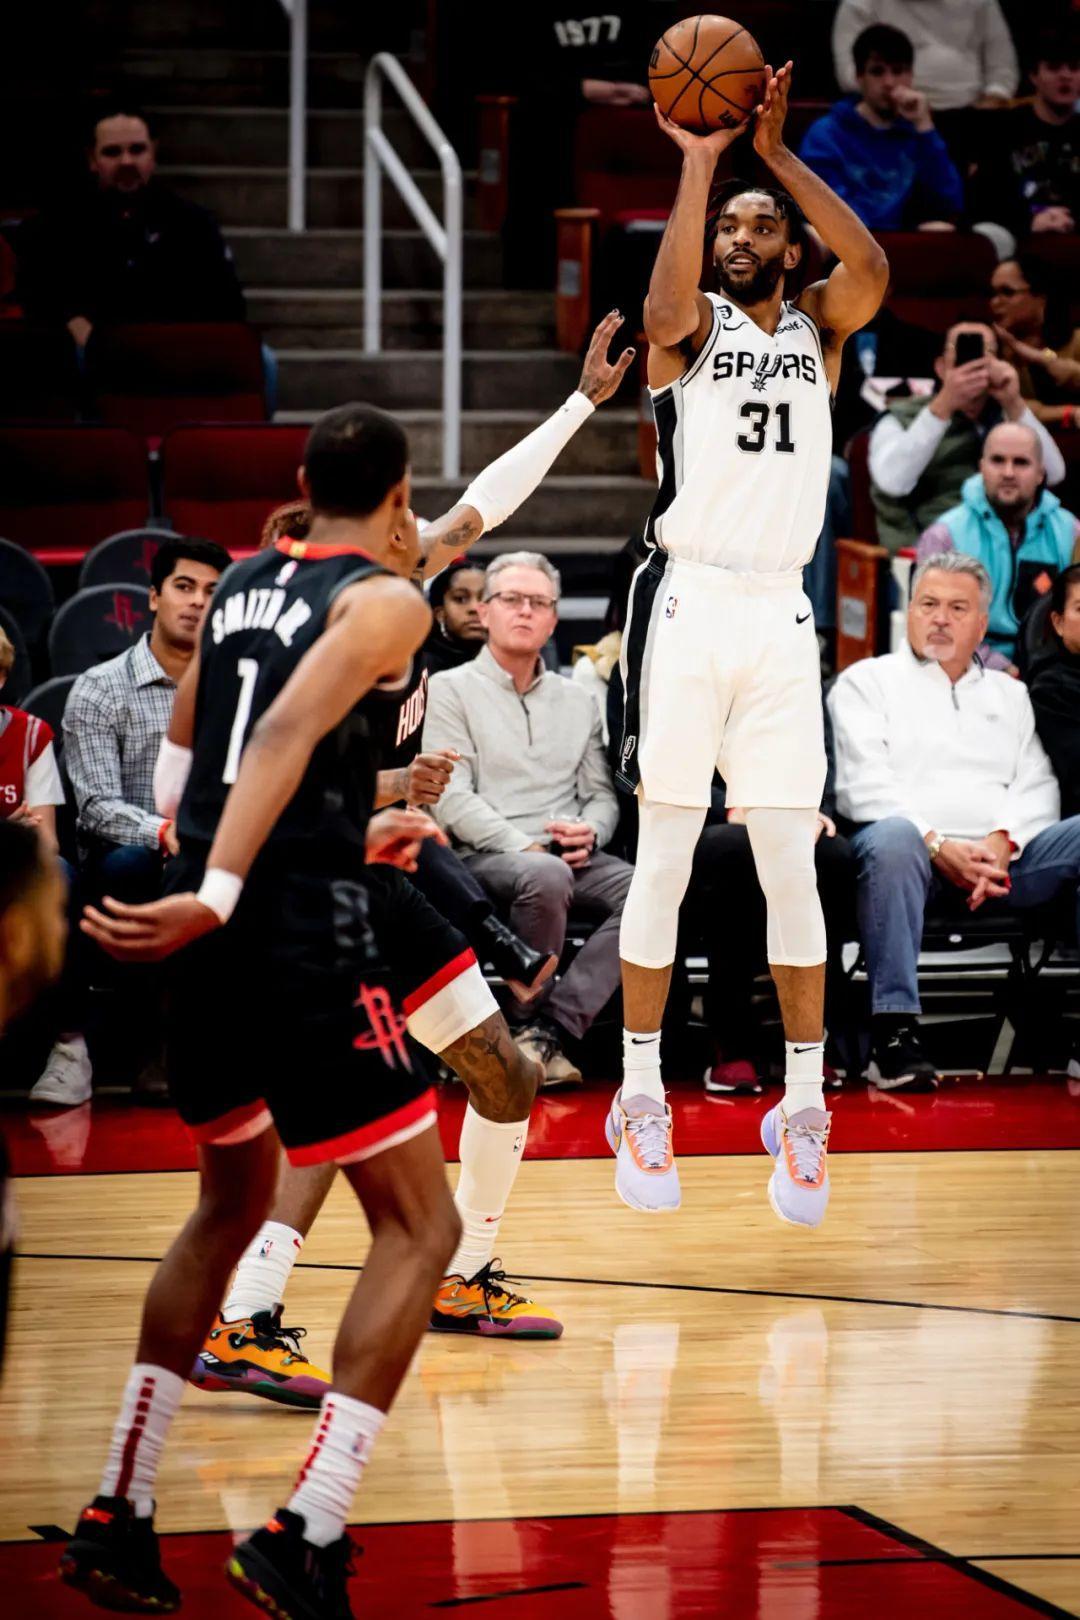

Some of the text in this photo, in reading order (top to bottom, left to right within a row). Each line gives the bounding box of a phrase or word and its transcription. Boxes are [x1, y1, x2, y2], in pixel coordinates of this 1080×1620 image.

[713, 351, 817, 392] SPURS
[735, 399, 797, 455] 31
[222, 658, 259, 784] 1
